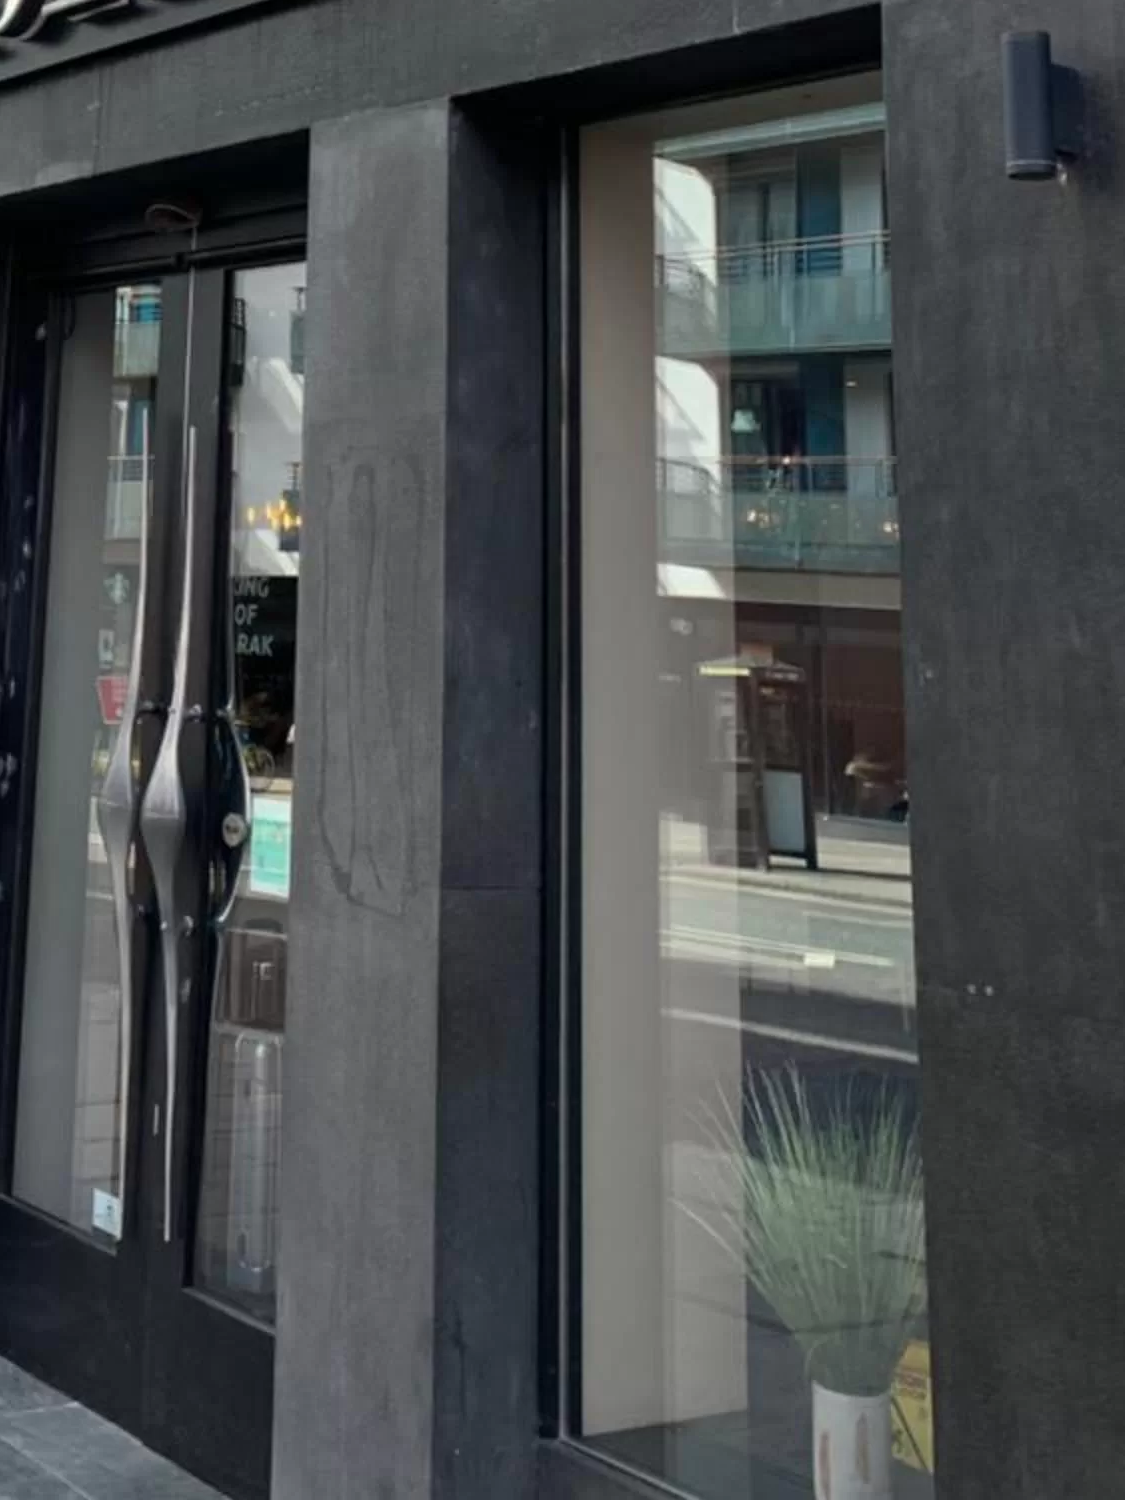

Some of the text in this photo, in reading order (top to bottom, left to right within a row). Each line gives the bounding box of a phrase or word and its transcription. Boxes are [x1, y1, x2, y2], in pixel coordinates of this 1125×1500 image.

[233, 576, 270, 598] ING
[234, 603, 259, 626] OF
[235, 632, 275, 657] RAK
